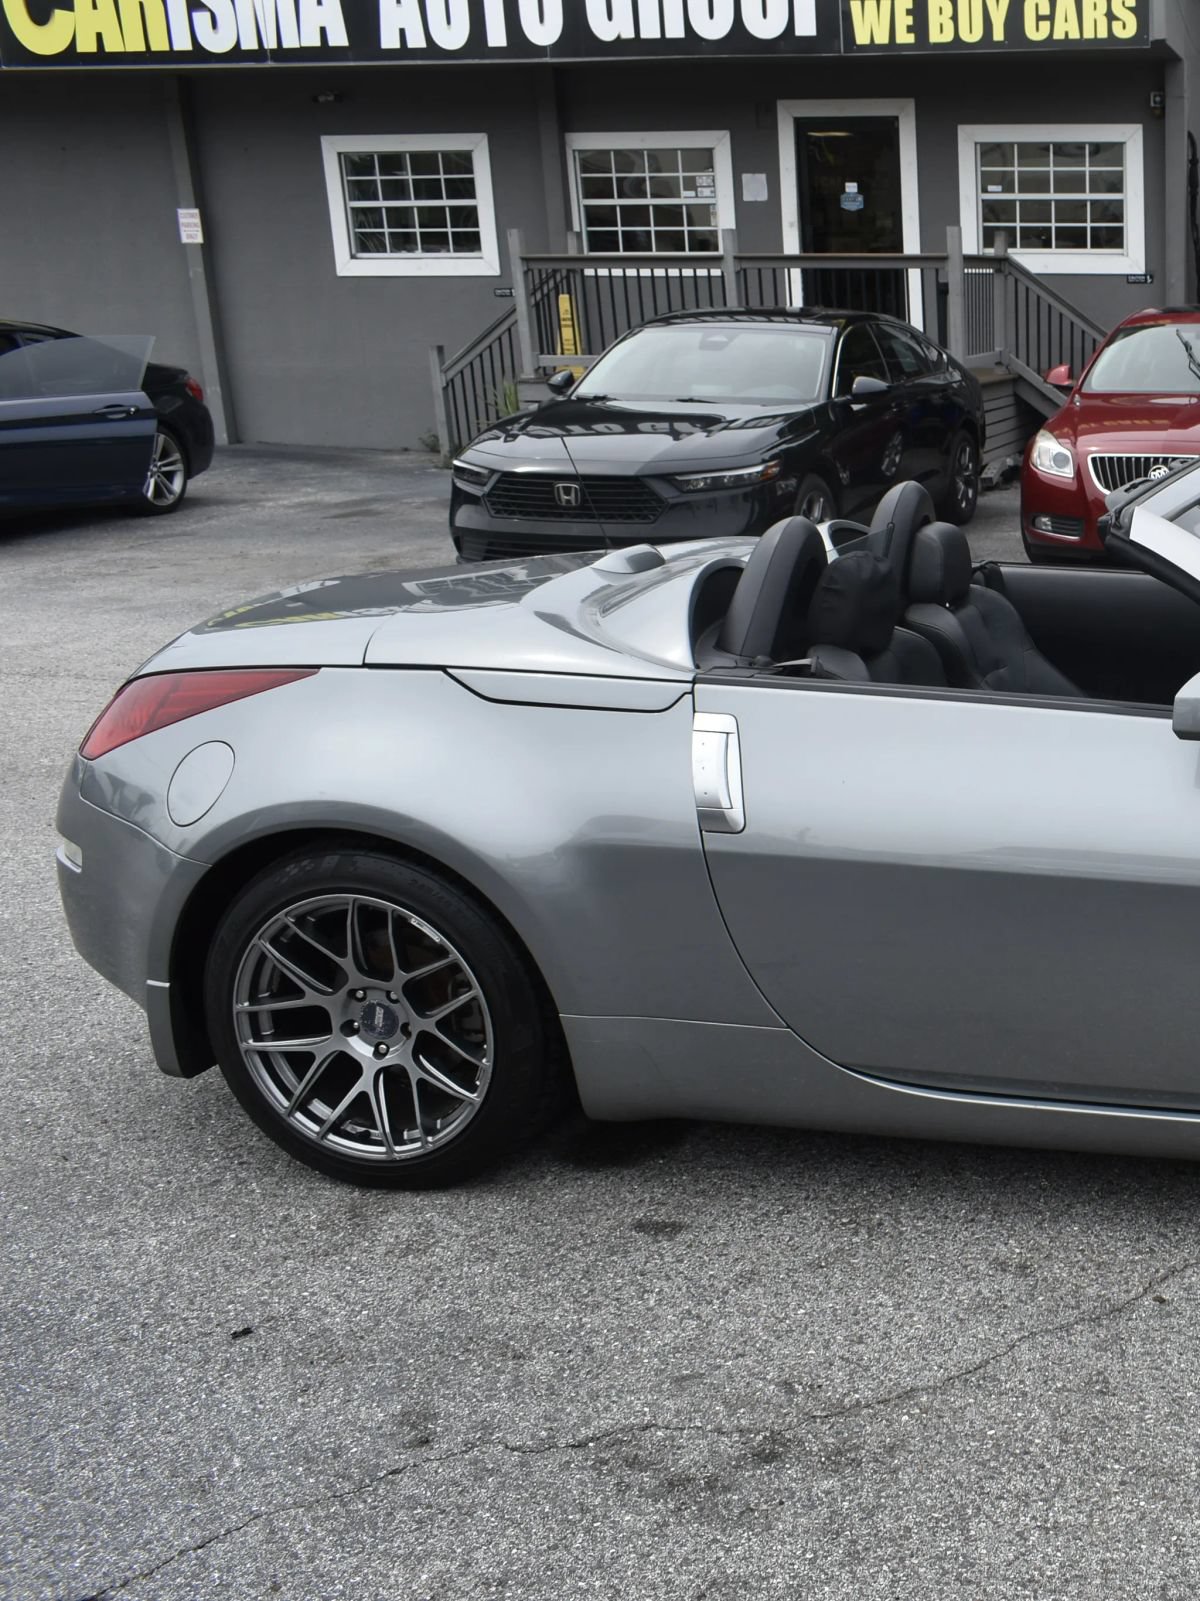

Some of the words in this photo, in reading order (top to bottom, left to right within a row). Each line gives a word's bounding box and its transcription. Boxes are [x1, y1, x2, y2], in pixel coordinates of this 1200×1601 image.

[850, 0, 915, 45] WE
[928, 0, 1009, 43] BUY
[1024, 0, 1137, 41] CARS
